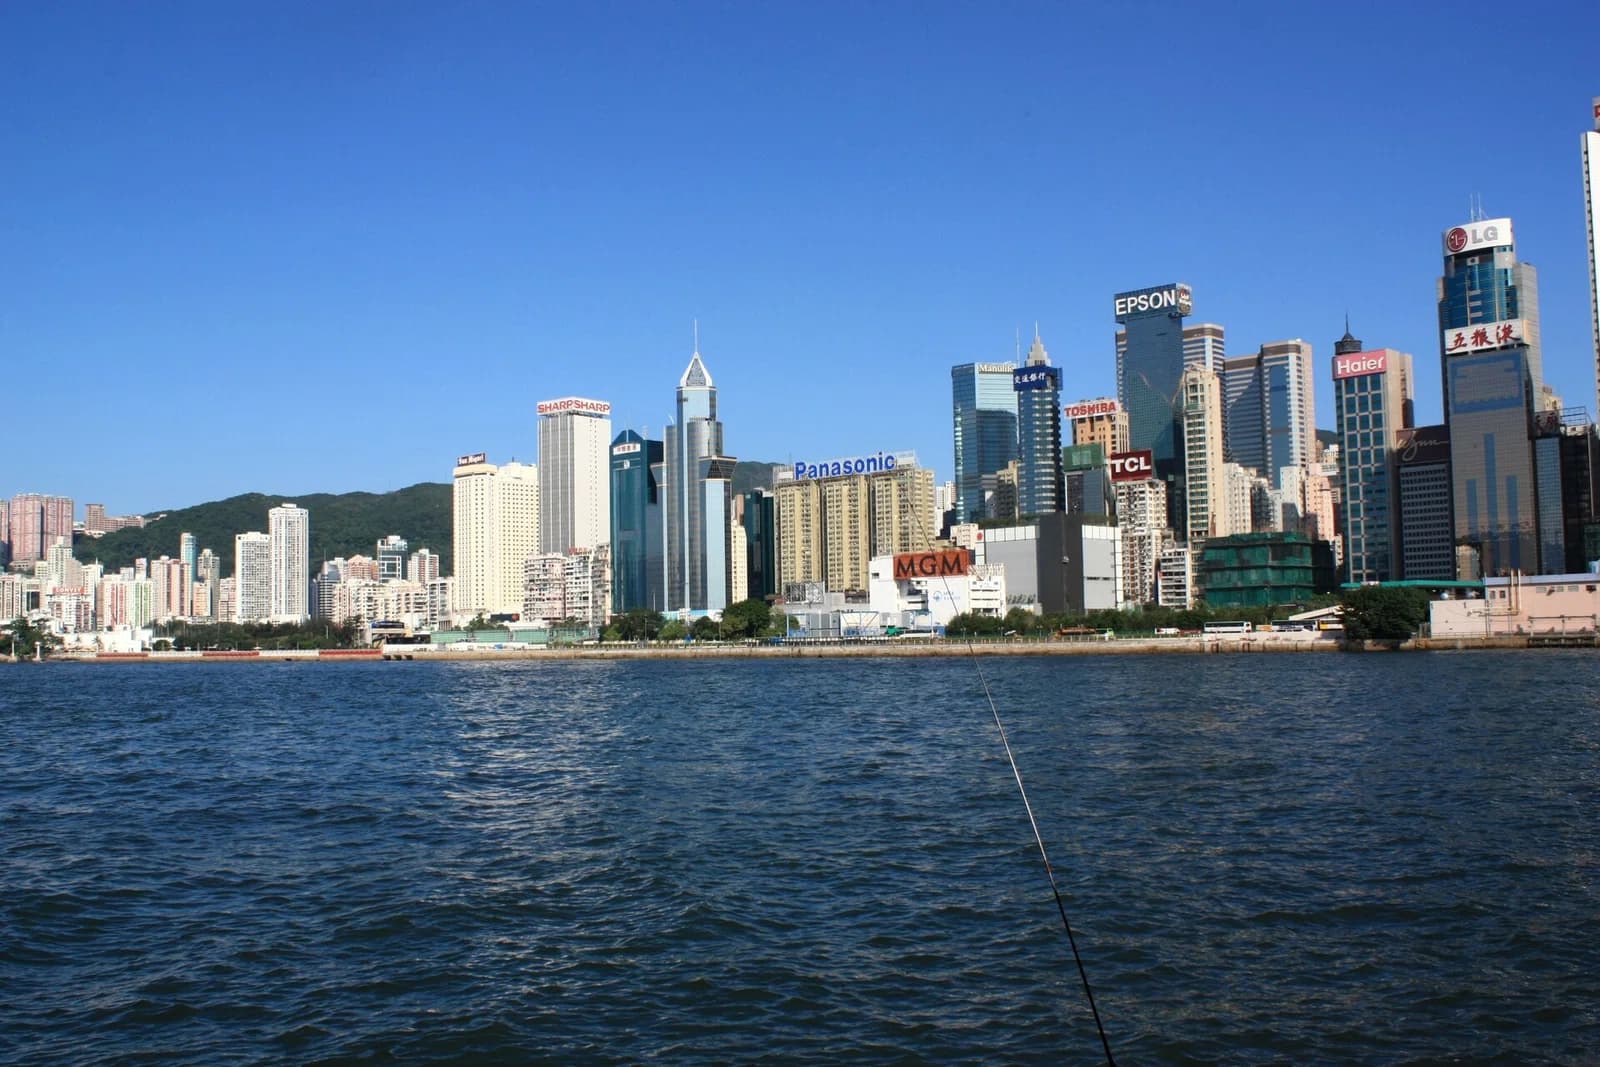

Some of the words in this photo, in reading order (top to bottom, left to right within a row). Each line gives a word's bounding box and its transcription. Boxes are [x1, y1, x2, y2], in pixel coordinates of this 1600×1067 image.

[1471, 226, 1498, 244] LG
[1115, 289, 1176, 315] EPSON
[1337, 356, 1384, 374] Haier
[538, 400, 573, 413] SHARP
[574, 400, 610, 413] SHARP
[1064, 401, 1117, 417] TOSHIBA
[795, 452, 896, 480] Panasonic
[1111, 456, 1151, 473] TCL
[896, 553, 964, 577] MGM
